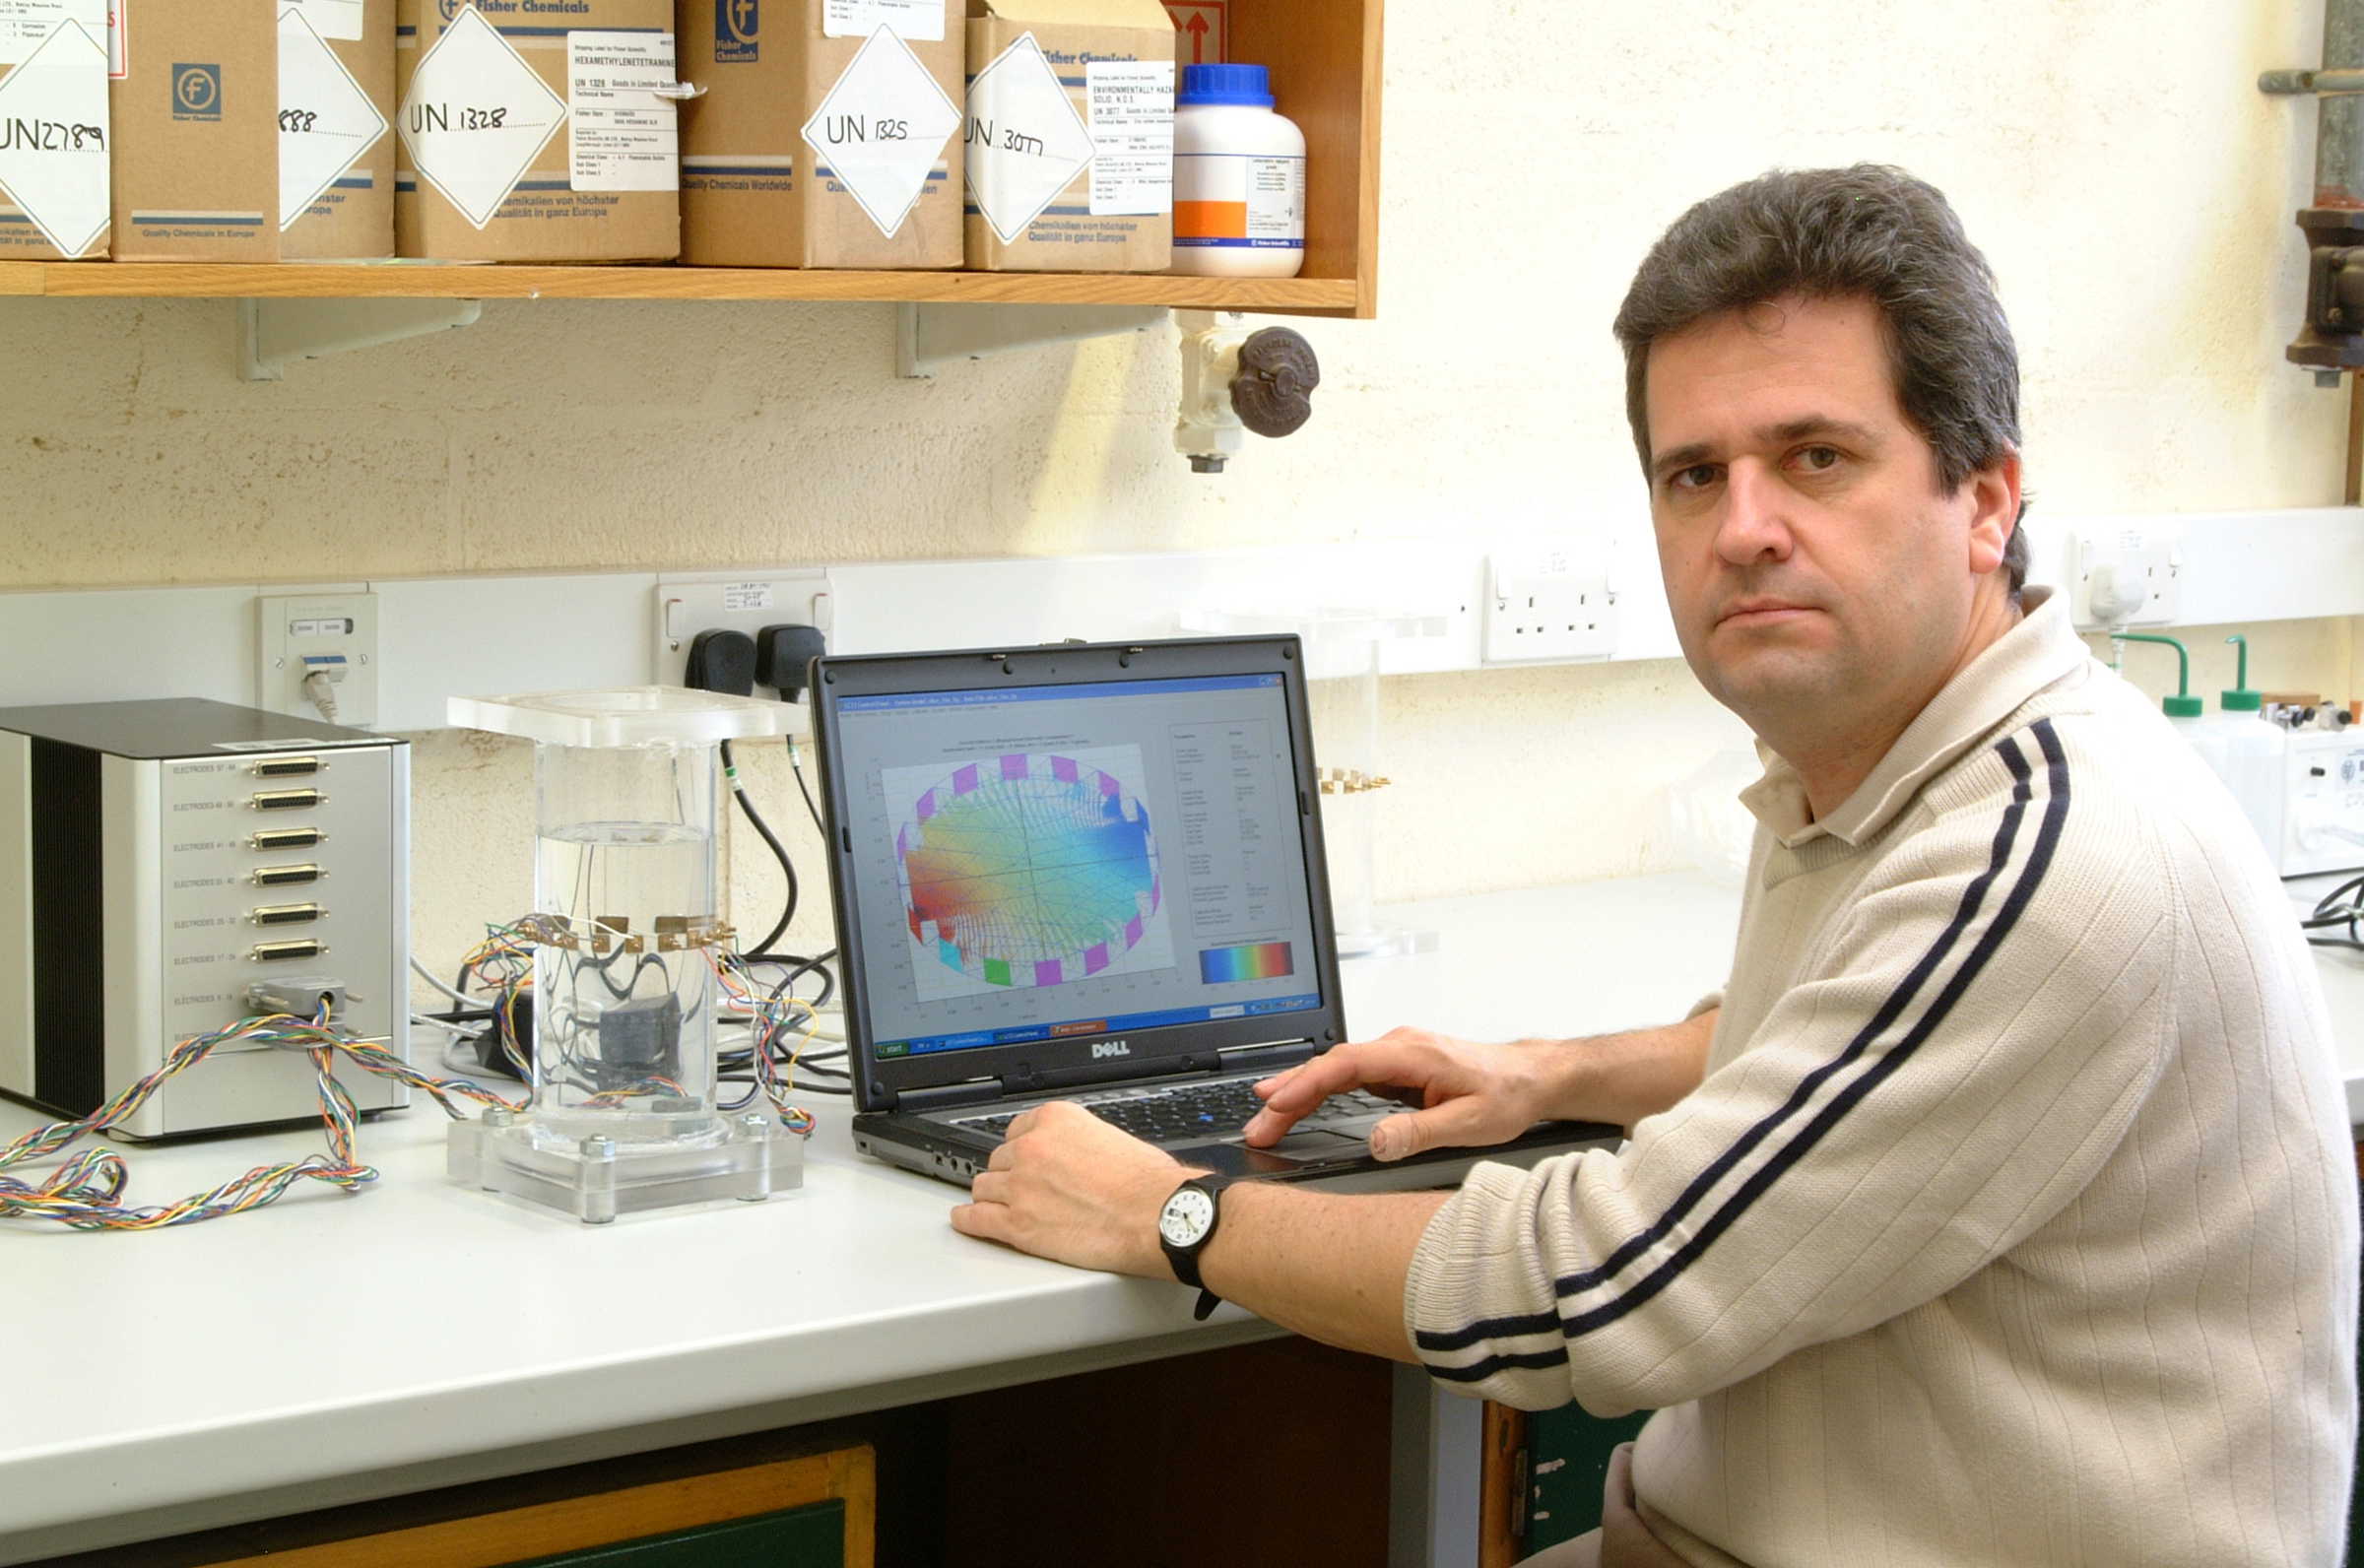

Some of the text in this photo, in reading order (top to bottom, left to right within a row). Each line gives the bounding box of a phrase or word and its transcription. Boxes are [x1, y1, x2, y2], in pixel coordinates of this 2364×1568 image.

[522, 0, 590, 14] Chemicals
[411, 102, 507, 133] UN 1328
[827, 114, 864, 144] UN
[709, 178, 749, 190] Chemicals
[503, 196, 554, 205] emikalien
[173, 229, 215, 237] Chemicals
[1091, 1042, 1131, 1059] DELL
